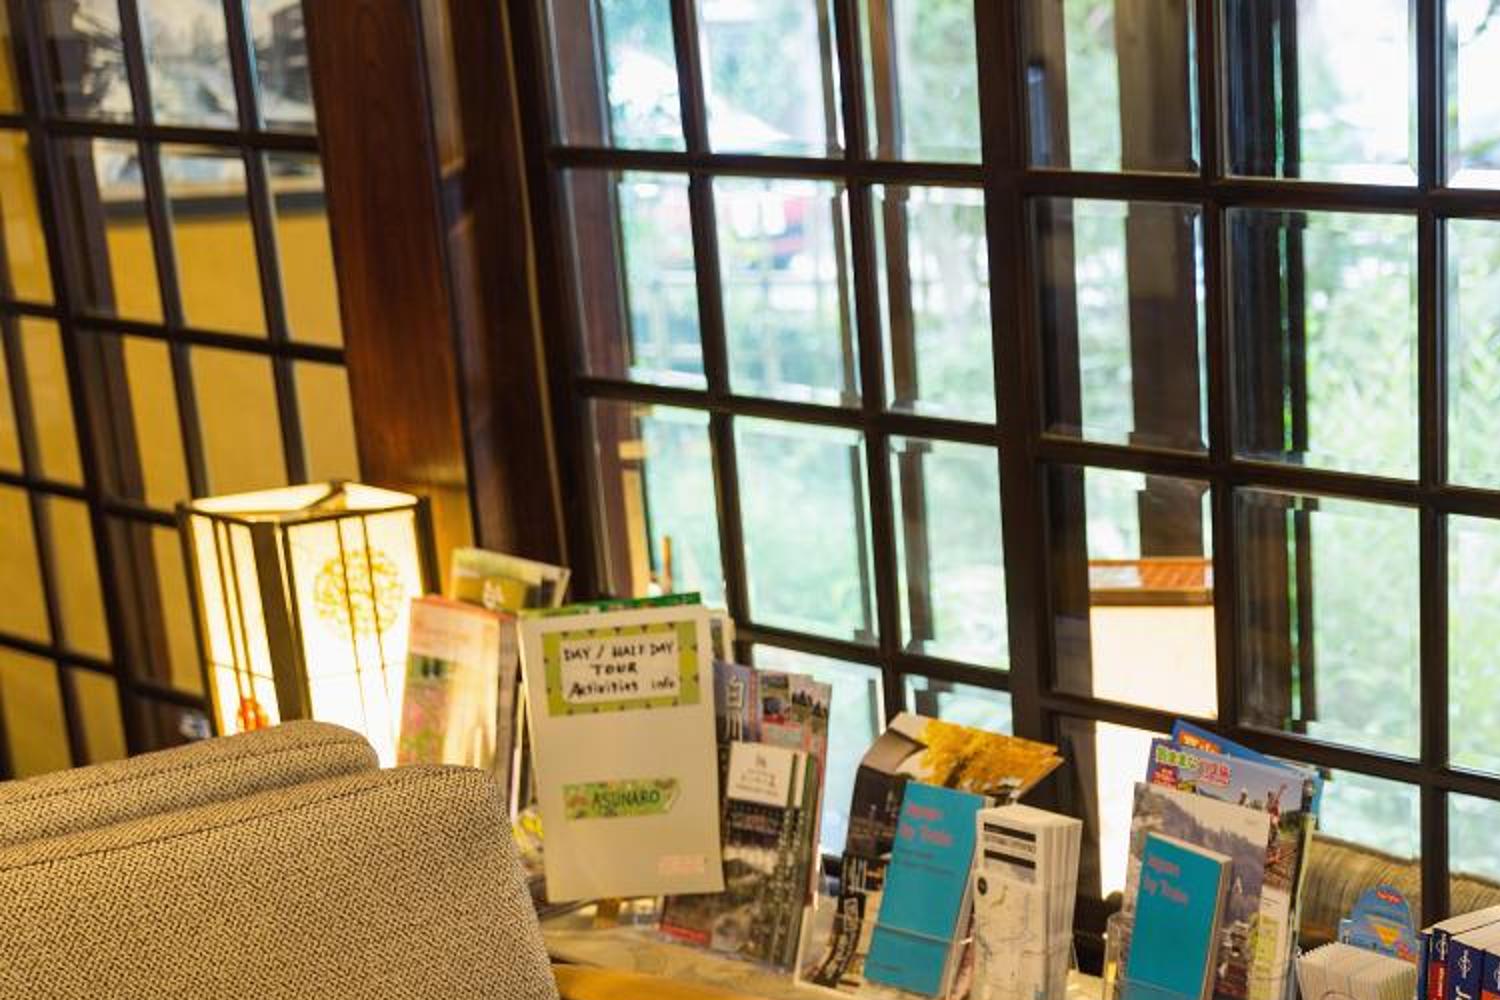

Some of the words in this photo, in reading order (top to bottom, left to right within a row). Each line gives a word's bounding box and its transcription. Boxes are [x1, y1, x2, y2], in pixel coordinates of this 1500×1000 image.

[564, 648, 589, 661] DAY
[649, 641, 673, 656] DAY
[590, 661, 638, 676] TOUR
[568, 682, 638, 699] Activities
[591, 790, 661, 811] ASUNARO
